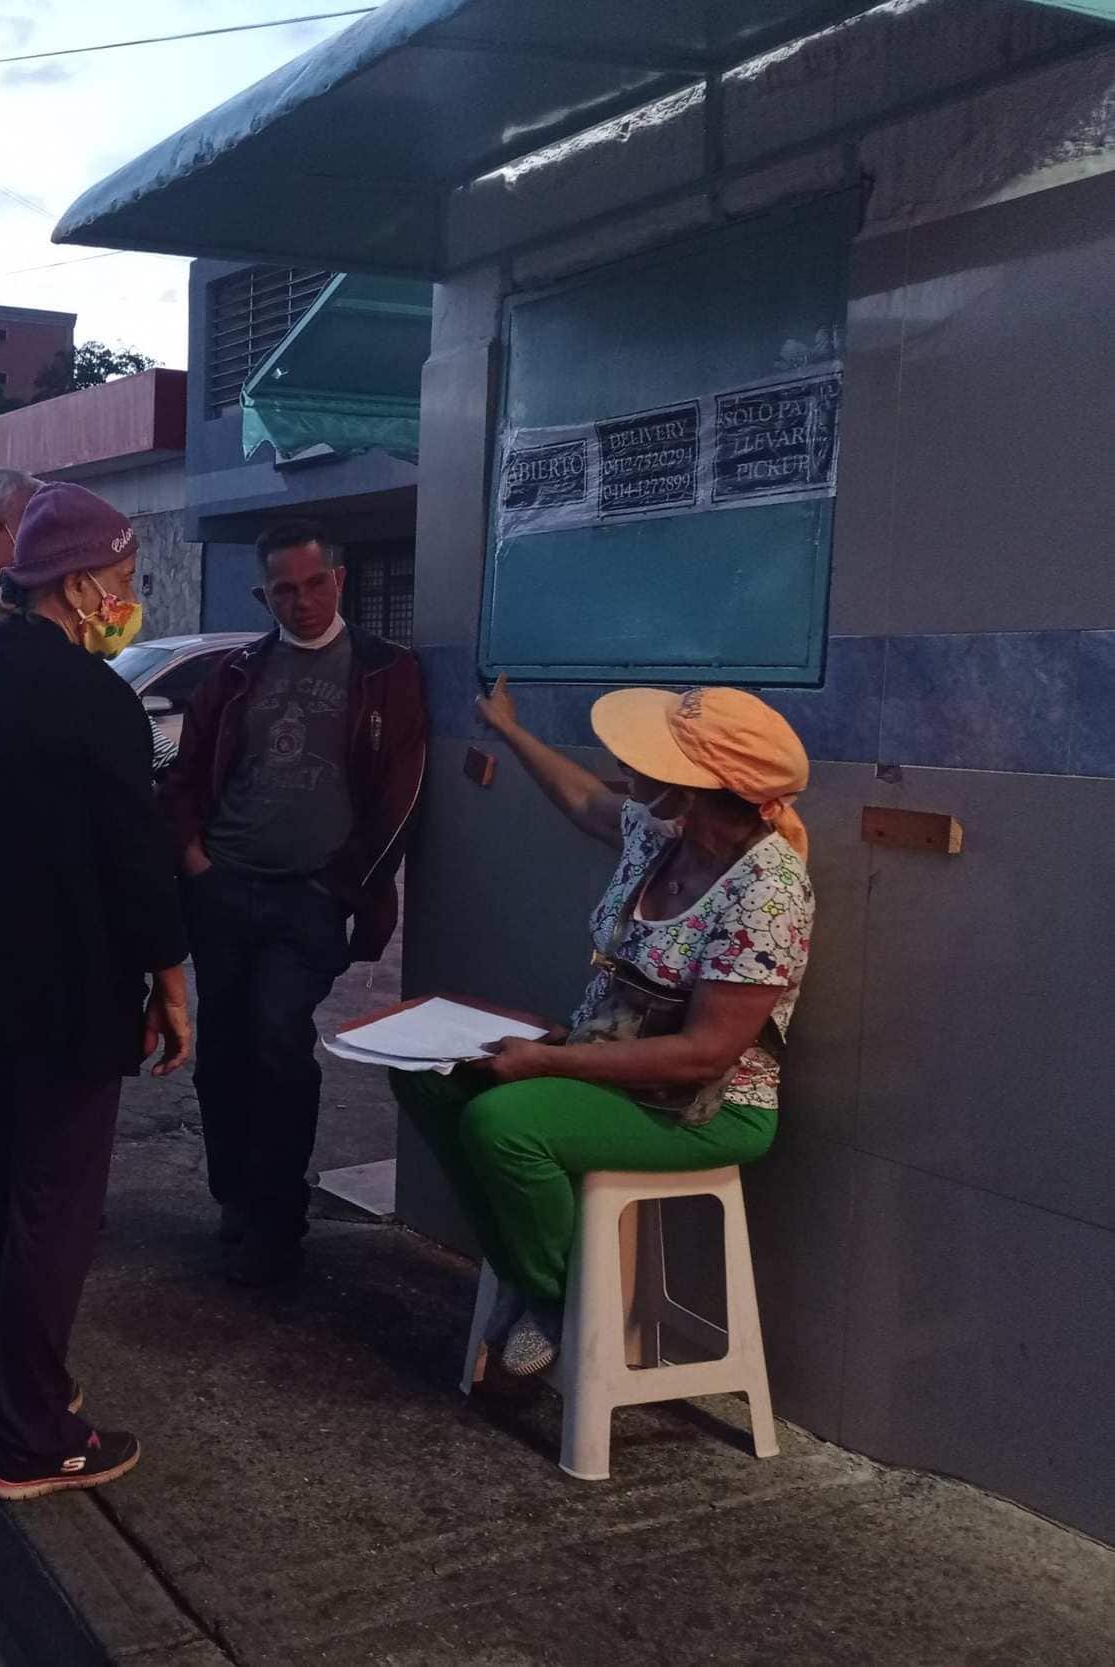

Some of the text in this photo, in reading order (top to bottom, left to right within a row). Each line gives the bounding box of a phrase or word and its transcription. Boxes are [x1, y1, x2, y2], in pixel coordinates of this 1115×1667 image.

[724, 403, 774, 427] SOLO
[608, 418, 688, 450] DELIVERY
[733, 427, 806, 455] LLEVAR
[506, 454, 584, 483] ABIERTO
[735, 454, 811, 482] PICKUP
